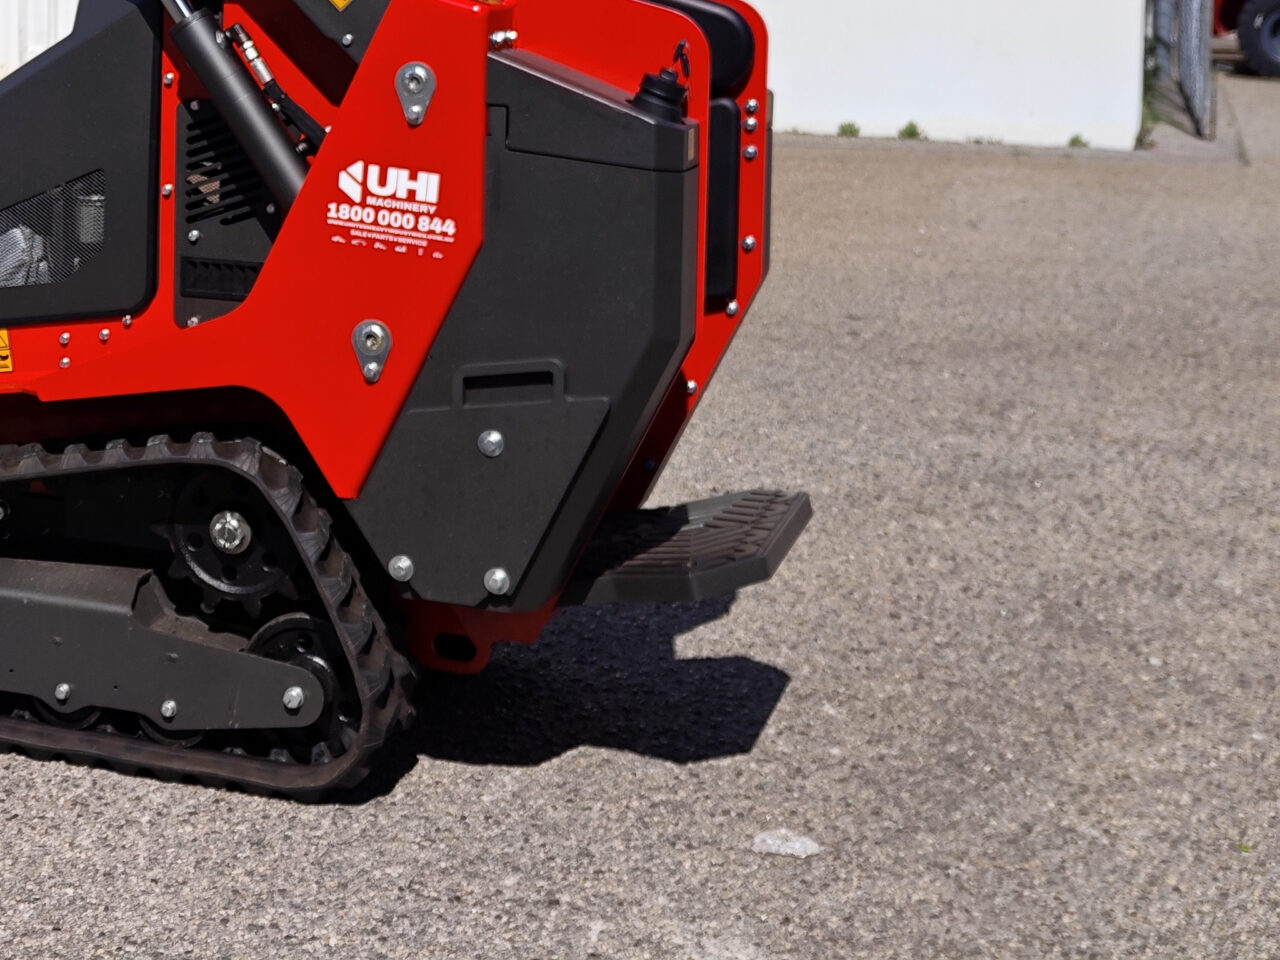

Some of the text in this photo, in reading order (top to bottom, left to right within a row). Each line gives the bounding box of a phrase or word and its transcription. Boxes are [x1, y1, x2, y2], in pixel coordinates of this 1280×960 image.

[366, 164, 441, 204] UHI
[327, 202, 456, 236] 1800 000 844
[366, 196, 437, 215] MACHINERY
